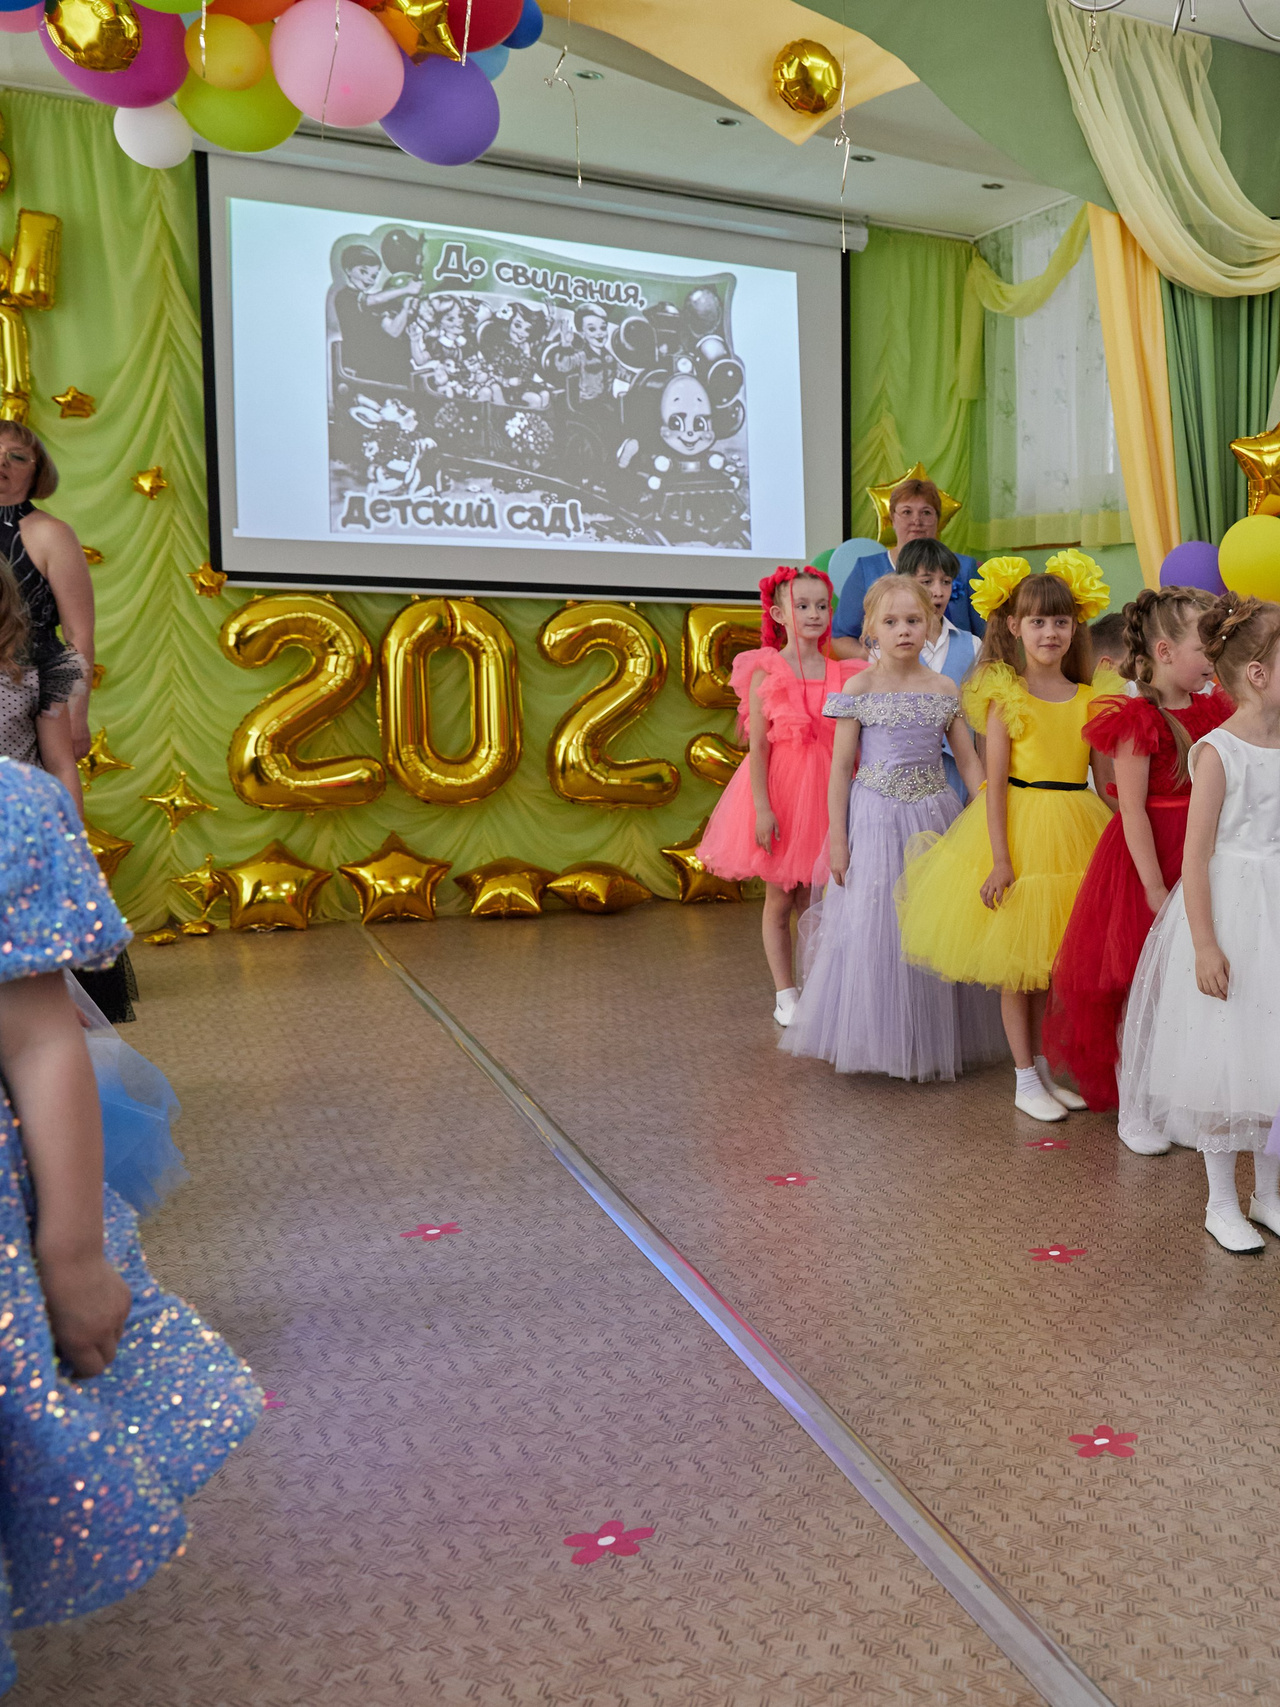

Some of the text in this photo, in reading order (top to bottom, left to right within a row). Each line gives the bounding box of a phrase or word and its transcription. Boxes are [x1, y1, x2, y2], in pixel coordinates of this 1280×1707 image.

[435, 243, 646, 308] До свидания,
[341, 495, 583, 538] детский сад!
